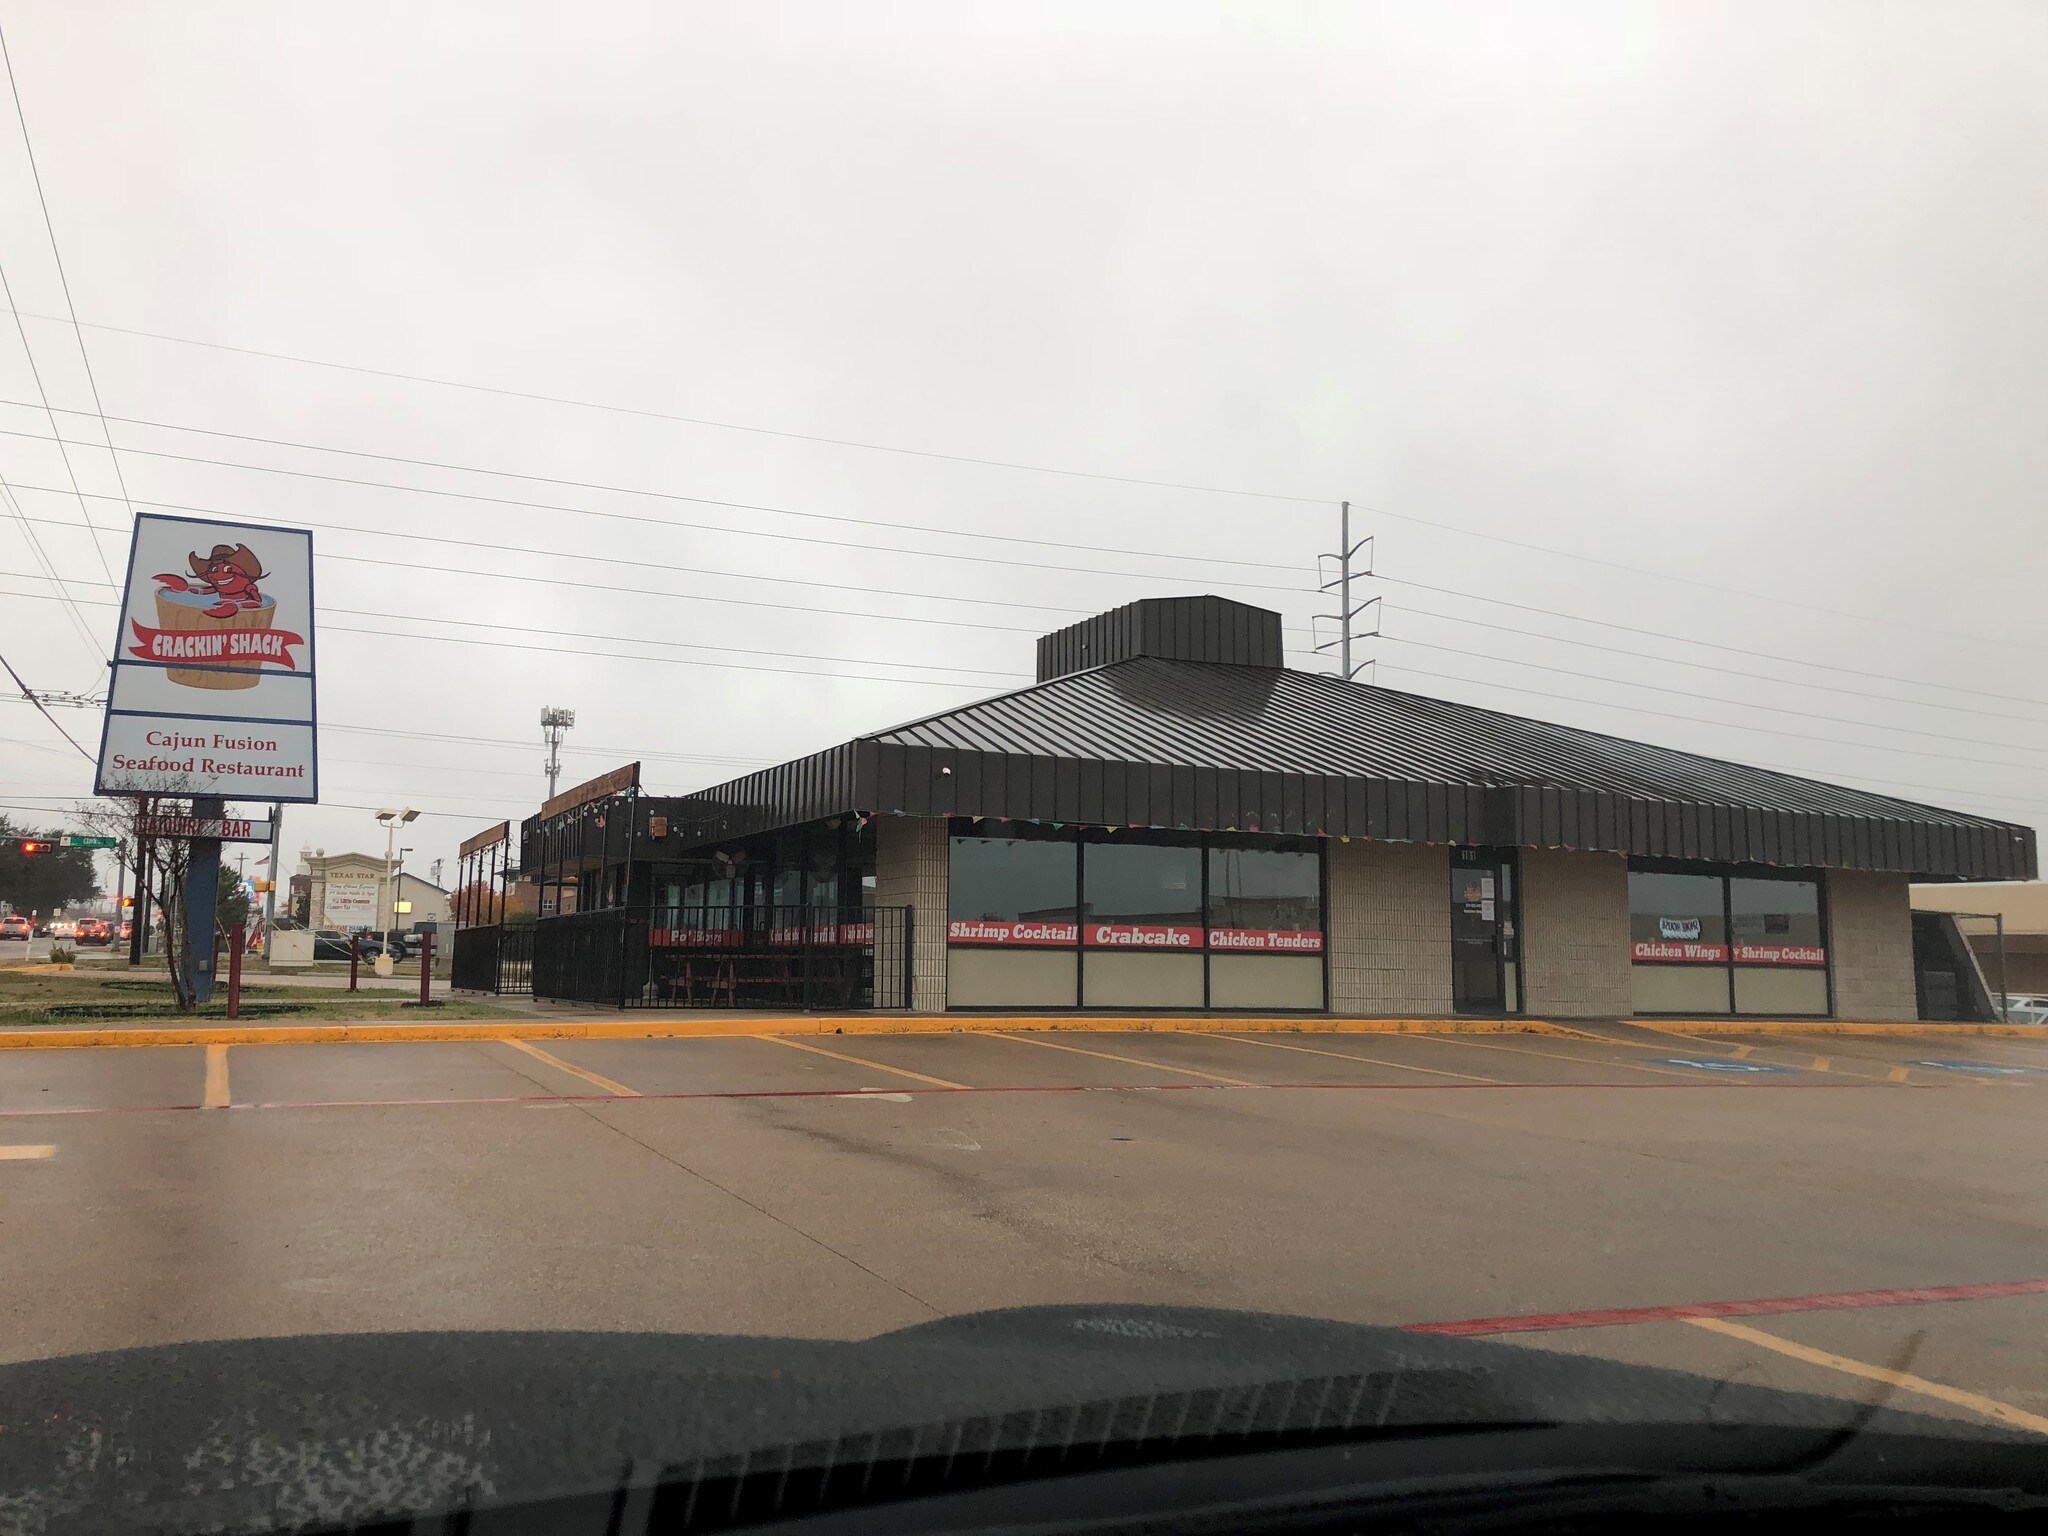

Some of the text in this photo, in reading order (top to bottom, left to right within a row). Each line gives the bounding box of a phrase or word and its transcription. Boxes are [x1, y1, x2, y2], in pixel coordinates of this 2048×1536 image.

[152, 633, 284, 658] CRACKIN' SHACK
[146, 731, 277, 751] Cajun Fusion
[112, 754, 305, 778] Seafood Restaurant
[222, 821, 251, 837] BAR
[949, 922, 1079, 941] Shrimp Cocktail
[1096, 926, 1191, 946] Crabcake
[1209, 931, 1321, 948] Chicken Tenders
[1635, 943, 1721, 960] Chicken Wings
[1742, 946, 1825, 961] Shrimp Cocktail
